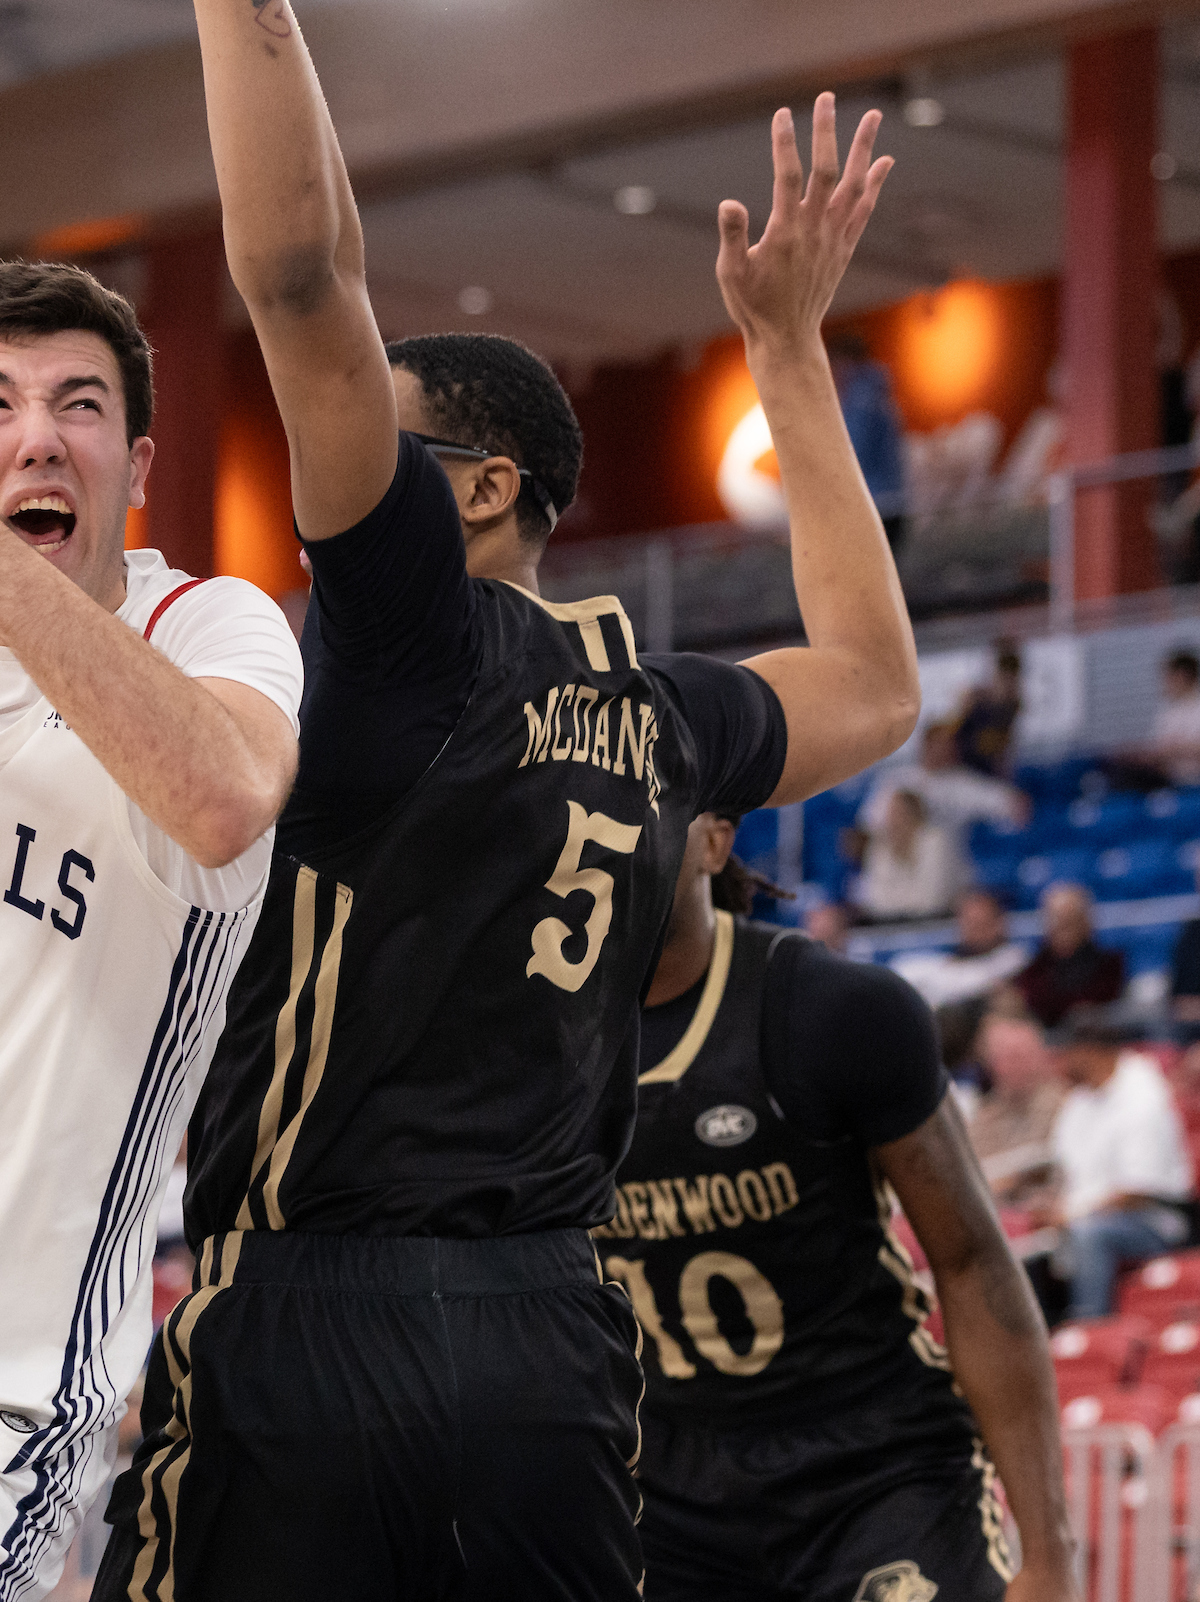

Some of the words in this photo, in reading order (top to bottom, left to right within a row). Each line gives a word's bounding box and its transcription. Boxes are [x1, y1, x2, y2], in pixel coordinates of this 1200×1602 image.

[517, 683, 661, 821] MCDAN
[526, 800, 643, 993] 5
[591, 1161, 800, 1240] DENWOOD
[606, 1251, 785, 1379] 10
